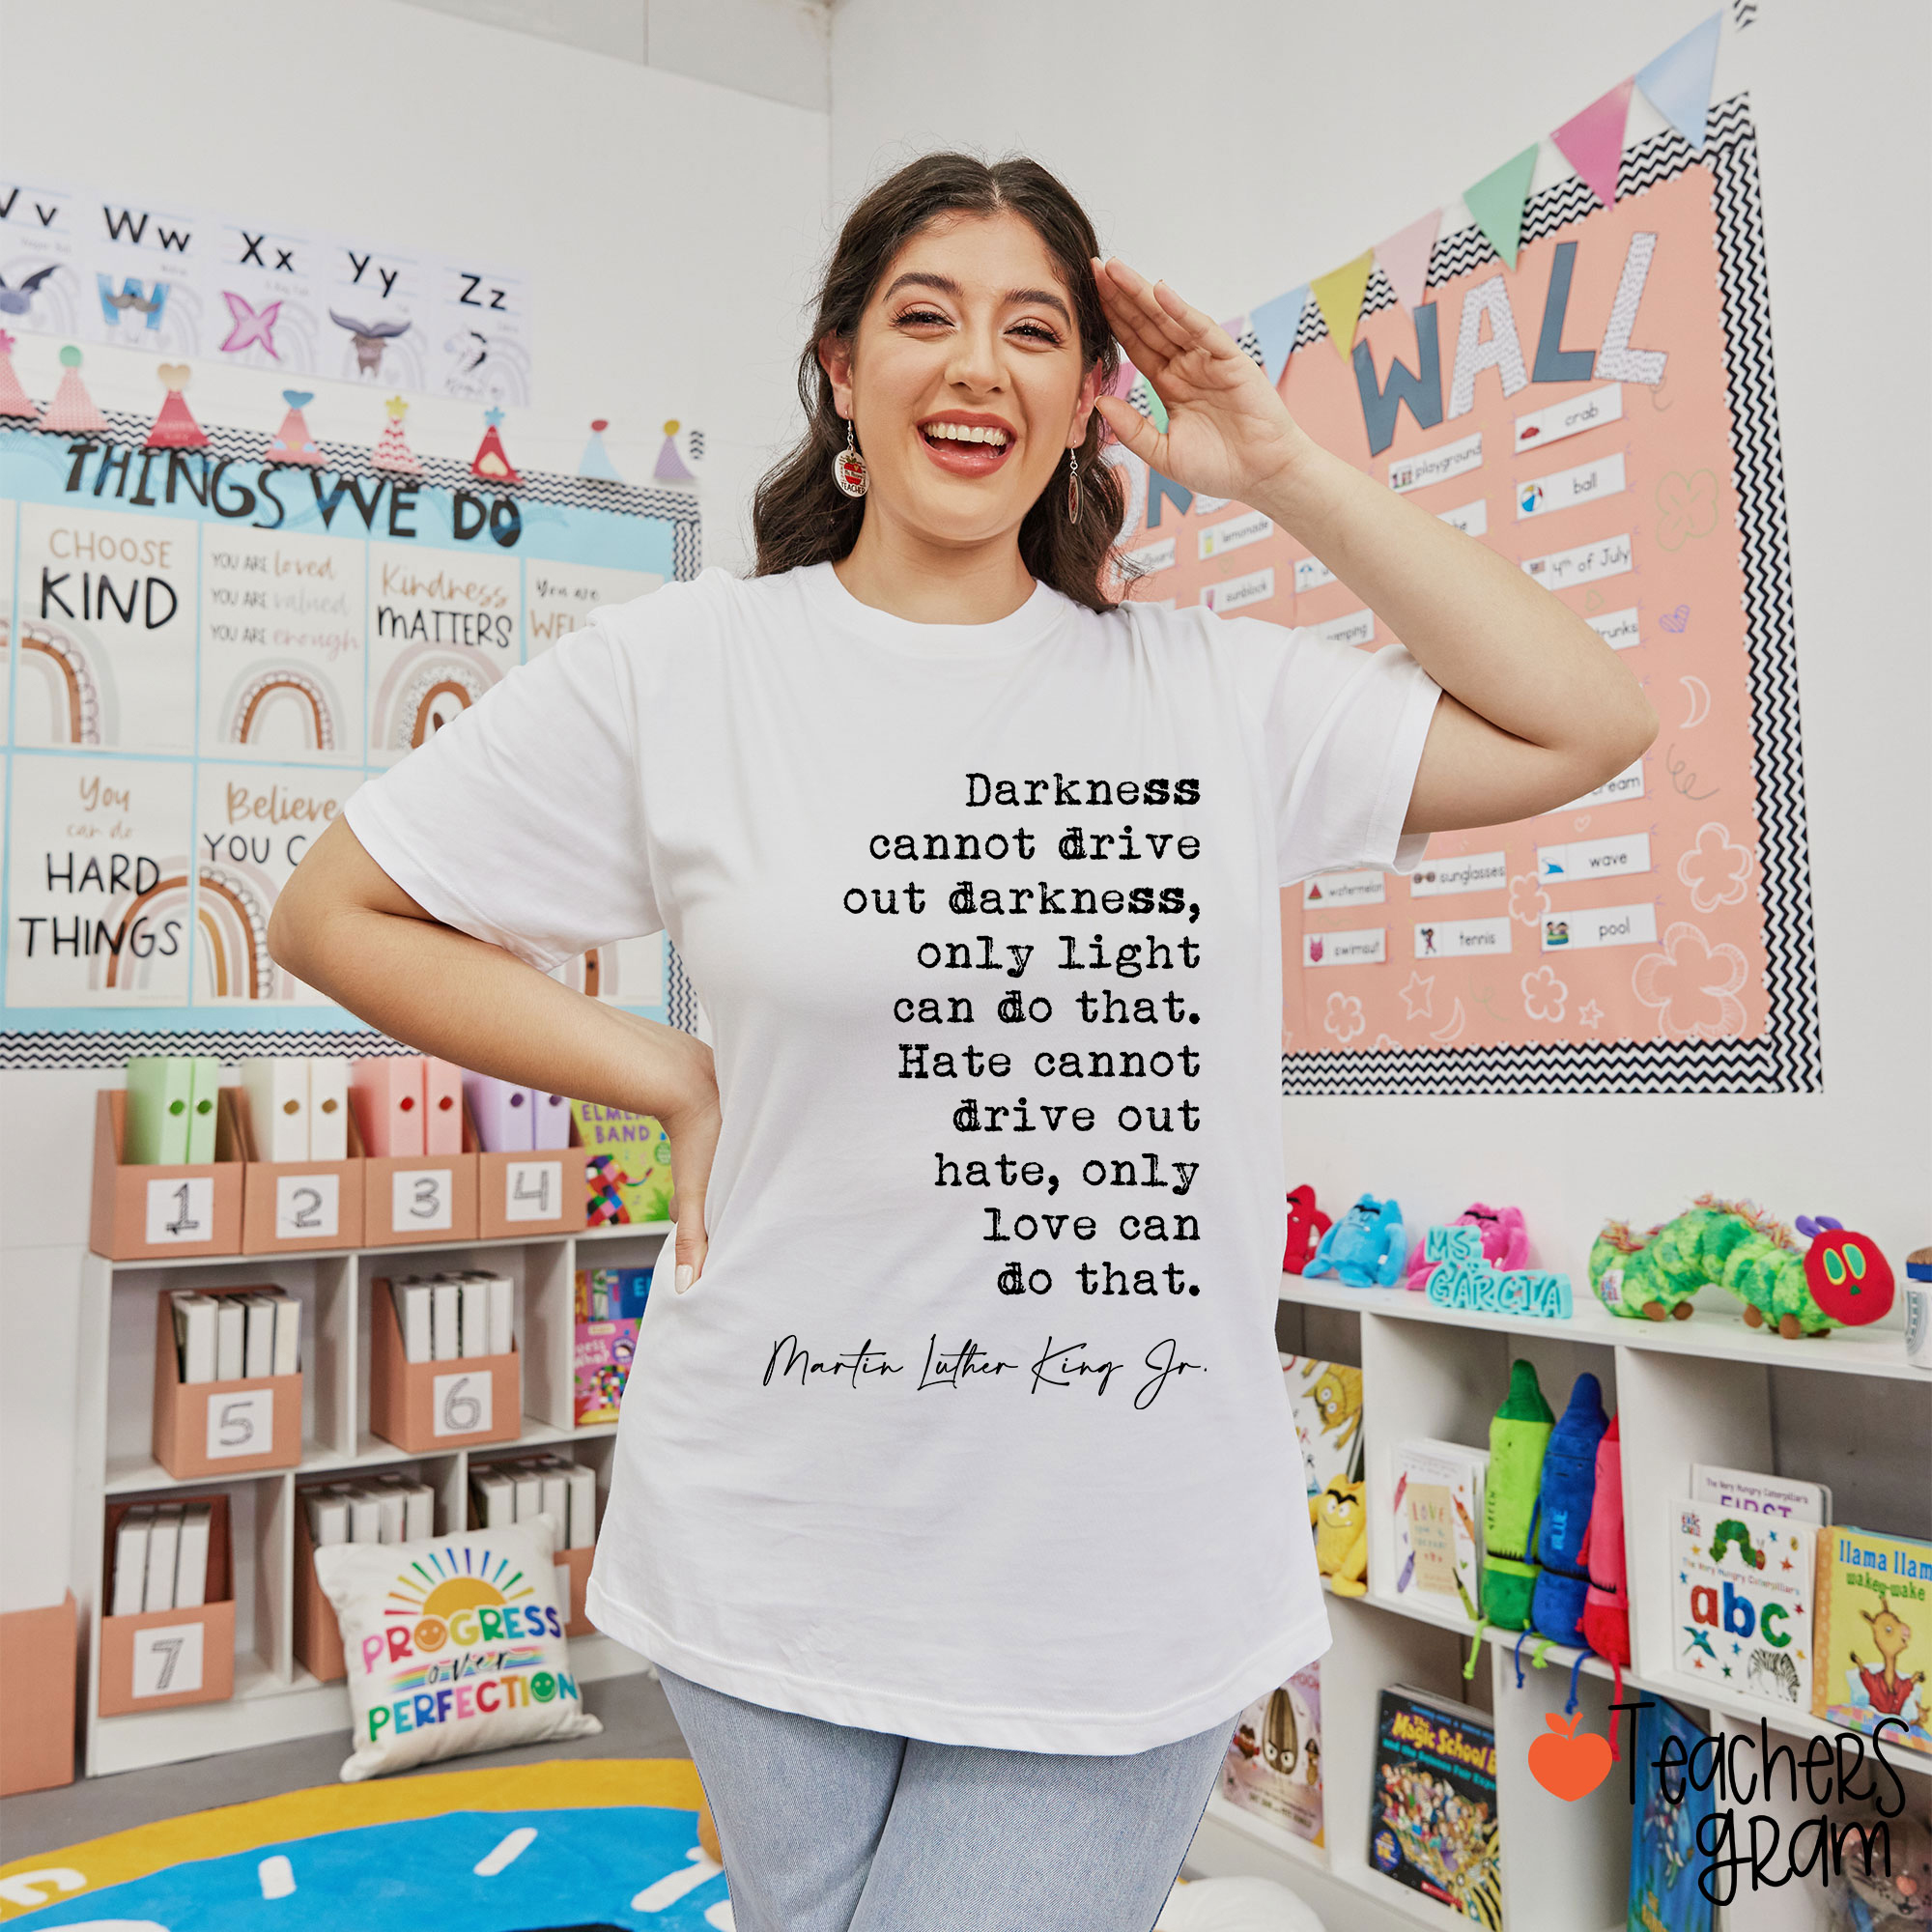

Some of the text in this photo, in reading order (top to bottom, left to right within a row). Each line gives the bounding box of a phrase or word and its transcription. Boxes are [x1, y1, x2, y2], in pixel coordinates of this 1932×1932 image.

[1351, 232, 1668, 457] WALL
[1565, 399, 1599, 427] crab
[1414, 437, 1482, 480] playground
[65, 443, 522, 548] THINGS WE DO
[1574, 472, 1598, 495] ball
[49, 528, 173, 569] CHOOSE
[1223, 520, 1268, 543] lemonade
[211, 550, 335, 580] YOU ARE loved
[1577, 553, 1595, 573] of
[1600, 545, 1632, 568] July
[42, 566, 177, 629] KIND
[211, 587, 240, 606] YOU
[242, 590, 268, 610] ARE
[382, 562, 508, 610] Kindness
[1226, 581, 1268, 602] sunblock
[210, 623, 360, 662] YOU ARE enough
[80, 775, 130, 812] You
[227, 781, 338, 825] Believe
[966, 773, 1200, 807] Darkness
[204, 834, 270, 864] YOU
[870, 826, 1200, 861] cannot drive
[1589, 850, 1629, 868] wave
[46, 851, 159, 896] HARD
[1328, 876, 1385, 898] watermelon
[1439, 862, 1507, 888] sunglasses
[844, 881, 1200, 923] out darkness,
[18, 916, 182, 957] THINGS
[1459, 929, 1497, 948] tennis
[1598, 917, 1631, 939] pool
[918, 934, 1200, 978] only light
[894, 990, 1200, 1024] can do that.
[898, 1044, 1200, 1078] Hate cannot
[595, 1124, 650, 1144] BAND
[953, 1097, 1200, 1132] drive out
[514, 1170, 550, 1211] 4
[935, 1152, 1200, 1195] hate, only
[165, 1183, 200, 1236] 1
[291, 1187, 323, 1228] 2
[410, 1177, 440, 1219] 3
[983, 1208, 1200, 1241] love can
[998, 1262, 1200, 1296] do that.
[1428, 1265, 1566, 1318] GARCIA
[763, 1334, 1208, 1410] Martin Luther King Jr.
[218, 1400, 255, 1447] 5
[443, 1377, 482, 1431] 6
[1839, 1539, 1888, 1573] llama
[1690, 1580, 1793, 1649] abc
[362, 1605, 562, 1675] PROGRESS
[151, 1636, 185, 1690] 7
[428, 1650, 512, 1685] over
[368, 1671, 580, 1743] PERFECTION
[1392, 1711, 1436, 1749] Magic
[1435, 1726, 1488, 1771] School
